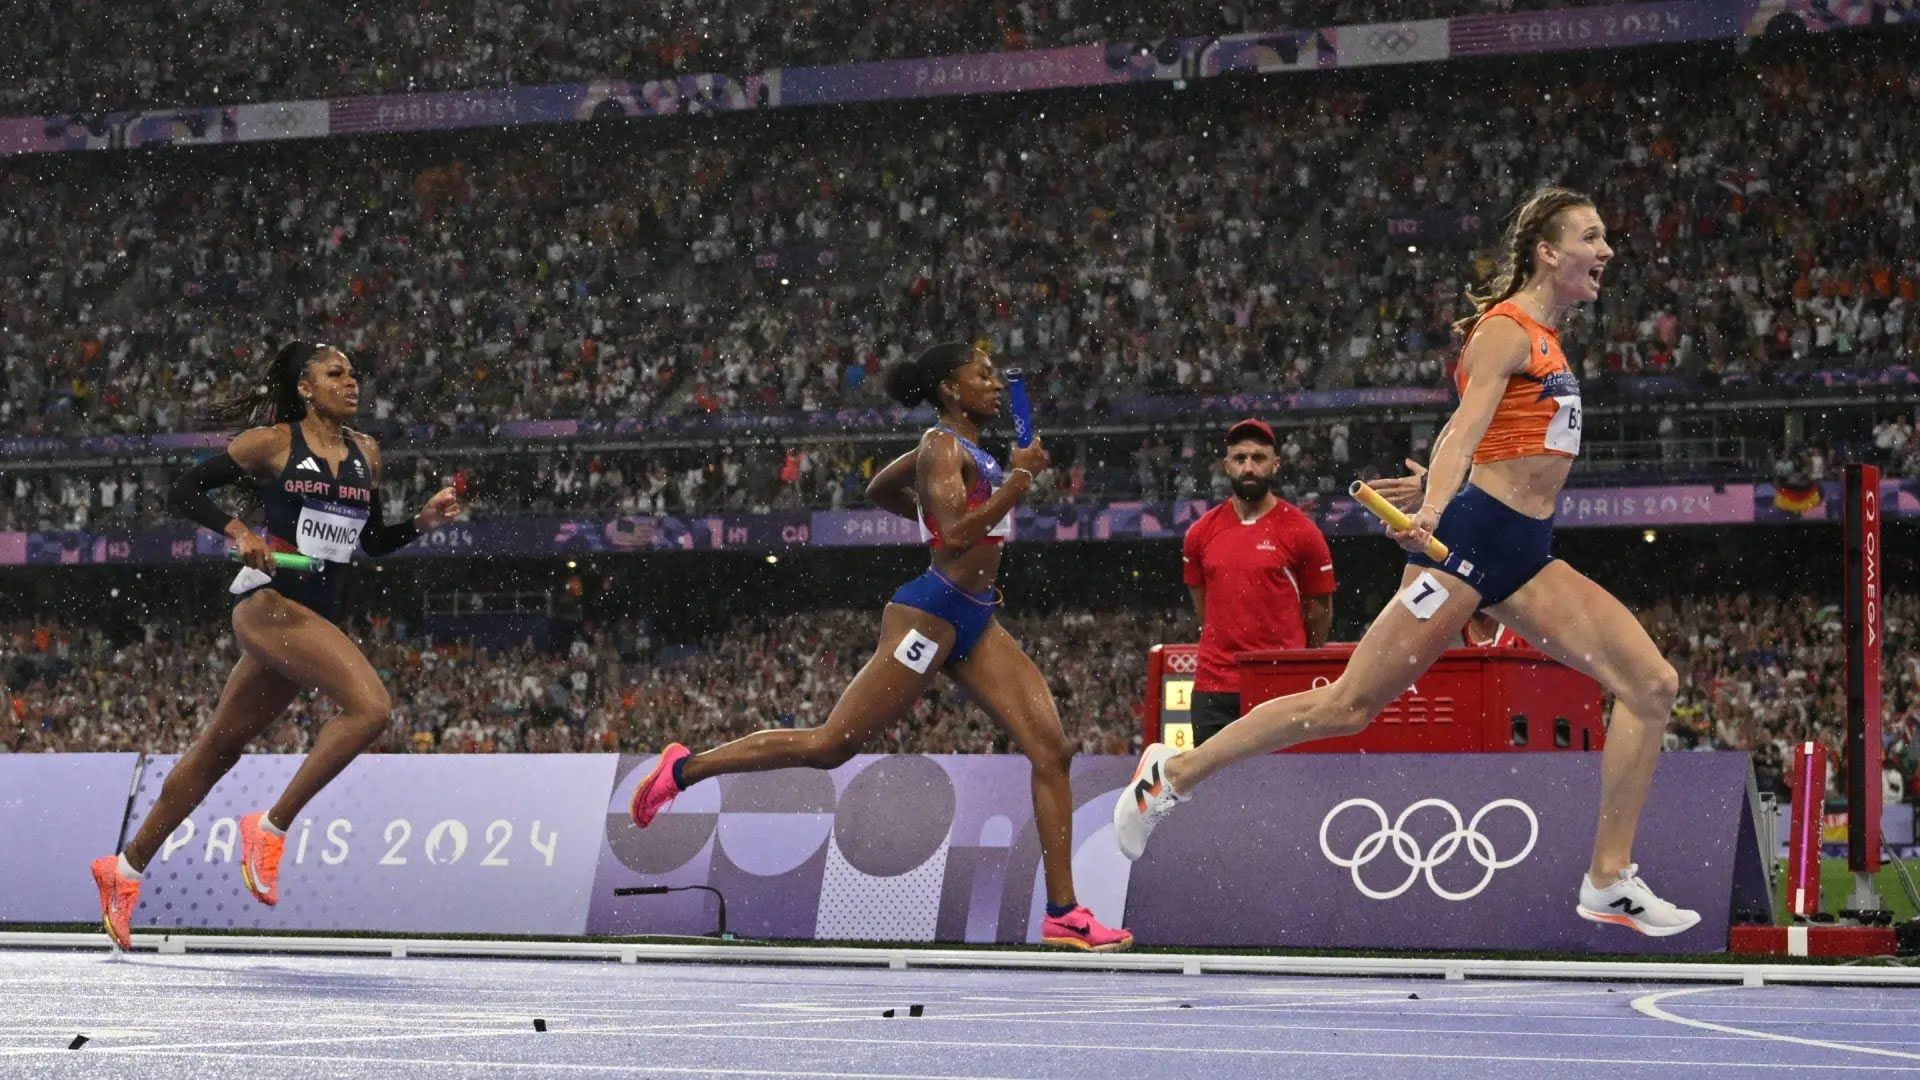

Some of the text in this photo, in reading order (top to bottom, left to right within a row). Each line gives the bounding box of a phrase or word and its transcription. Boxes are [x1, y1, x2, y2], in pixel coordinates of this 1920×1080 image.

[1508, 12, 1680, 43] PARIS 2024
[284, 480, 331, 496] GREAT
[1561, 495, 1712, 516] PARIS 2024
[1413, 581, 1436, 604] 7
[1866, 532, 1876, 647] OMEGA
[906, 640, 926, 662] 5
[1176, 689, 1186, 705] 1
[1175, 730, 1185, 747] 8
[378, 817, 559, 867] 2024
